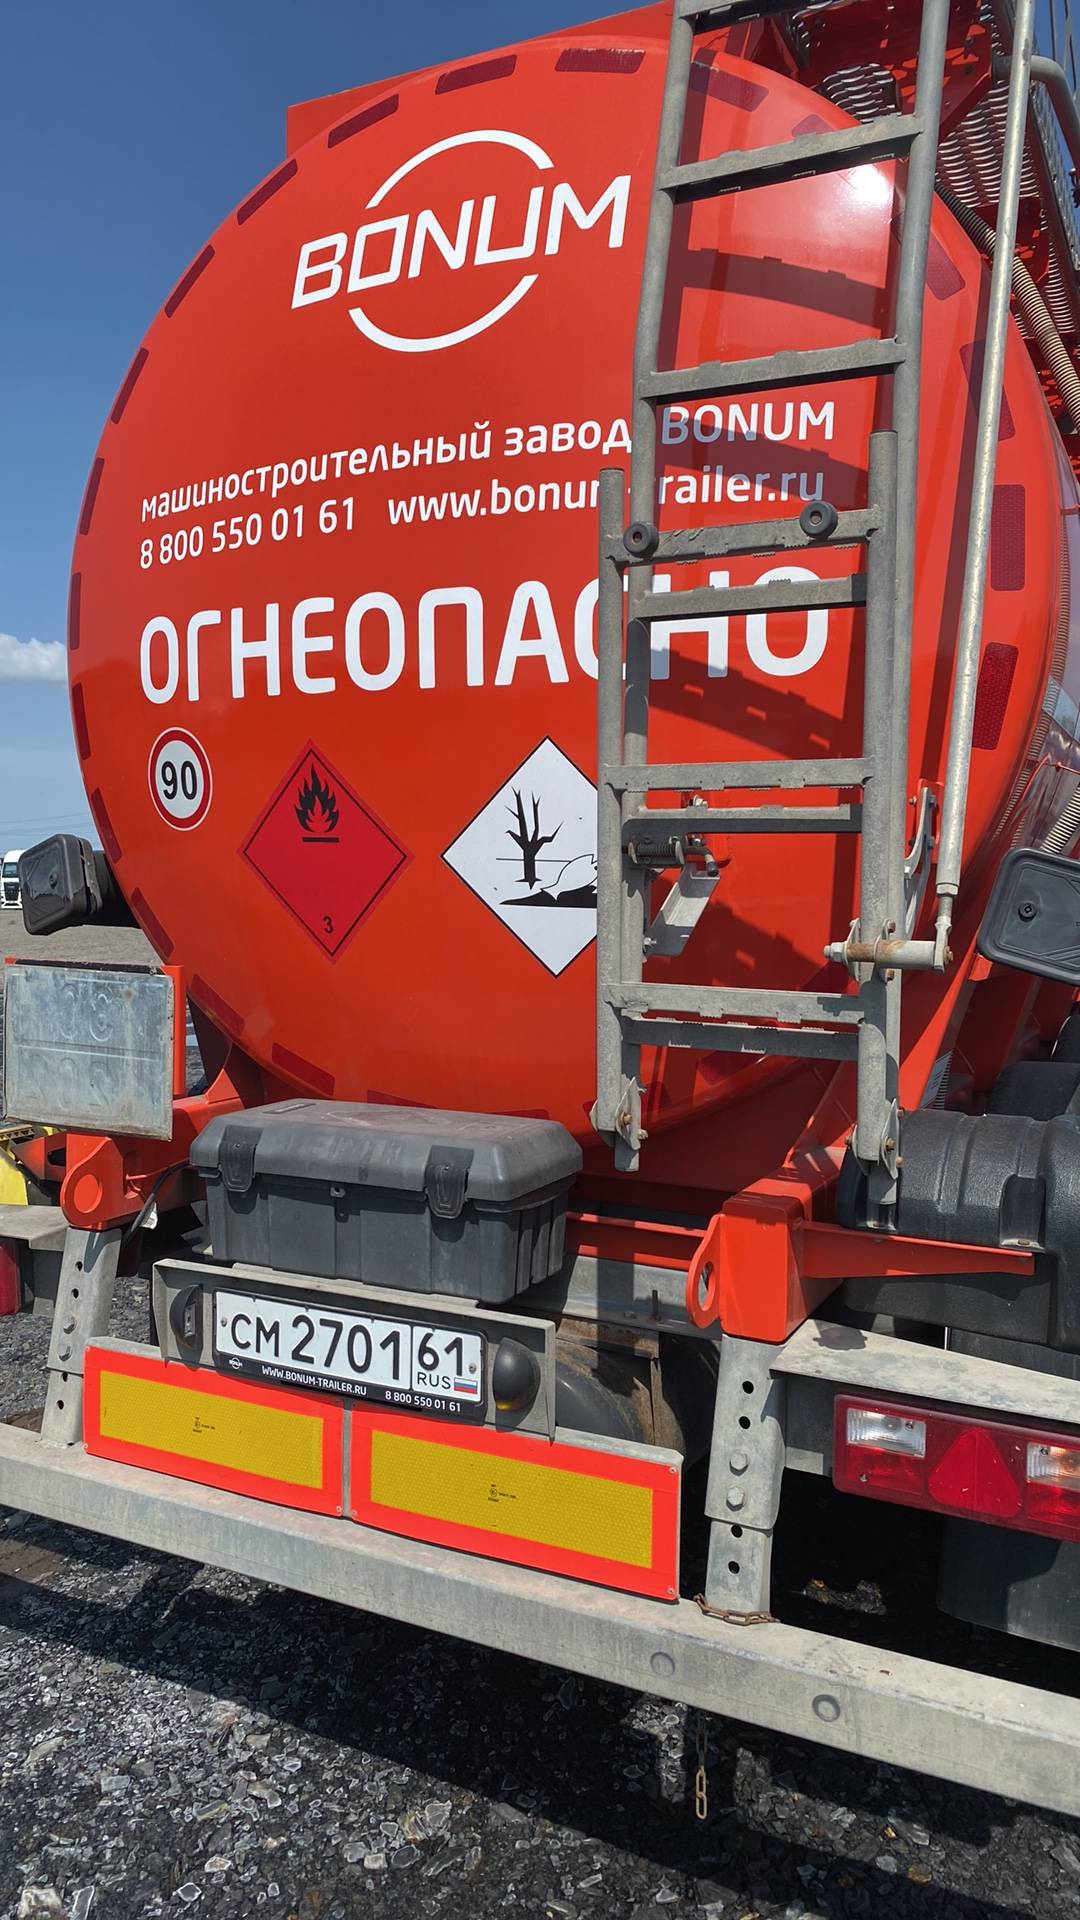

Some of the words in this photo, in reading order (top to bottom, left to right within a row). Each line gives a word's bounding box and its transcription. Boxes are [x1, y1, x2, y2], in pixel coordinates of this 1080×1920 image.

[291, 175, 631, 309] BONUM
[140, 421, 492, 523] машиностроительный
[505, 419, 631, 457] завод
[661, 402, 834, 445] BONUM
[139, 540, 153, 569] 8
[159, 527, 204, 564] 800
[211, 512, 262, 552] 550
[270, 505, 305, 541] 01
[318, 497, 356, 533] 61
[161, 760, 198, 801] 90
[322, 916, 334, 934] 3
[417, 1332, 464, 1377] 61
[262, 1365, 367, 1396] WWW.BONUM-TRAILER.RU
[417, 1371, 452, 1390] RUS
[385, 1391, 392, 1400] 8
[394, 1393, 411, 1404] 800
[414, 1397, 431, 1408] 550
[434, 1400, 446, 1410] 01
[449, 1402, 461, 1412] 61
